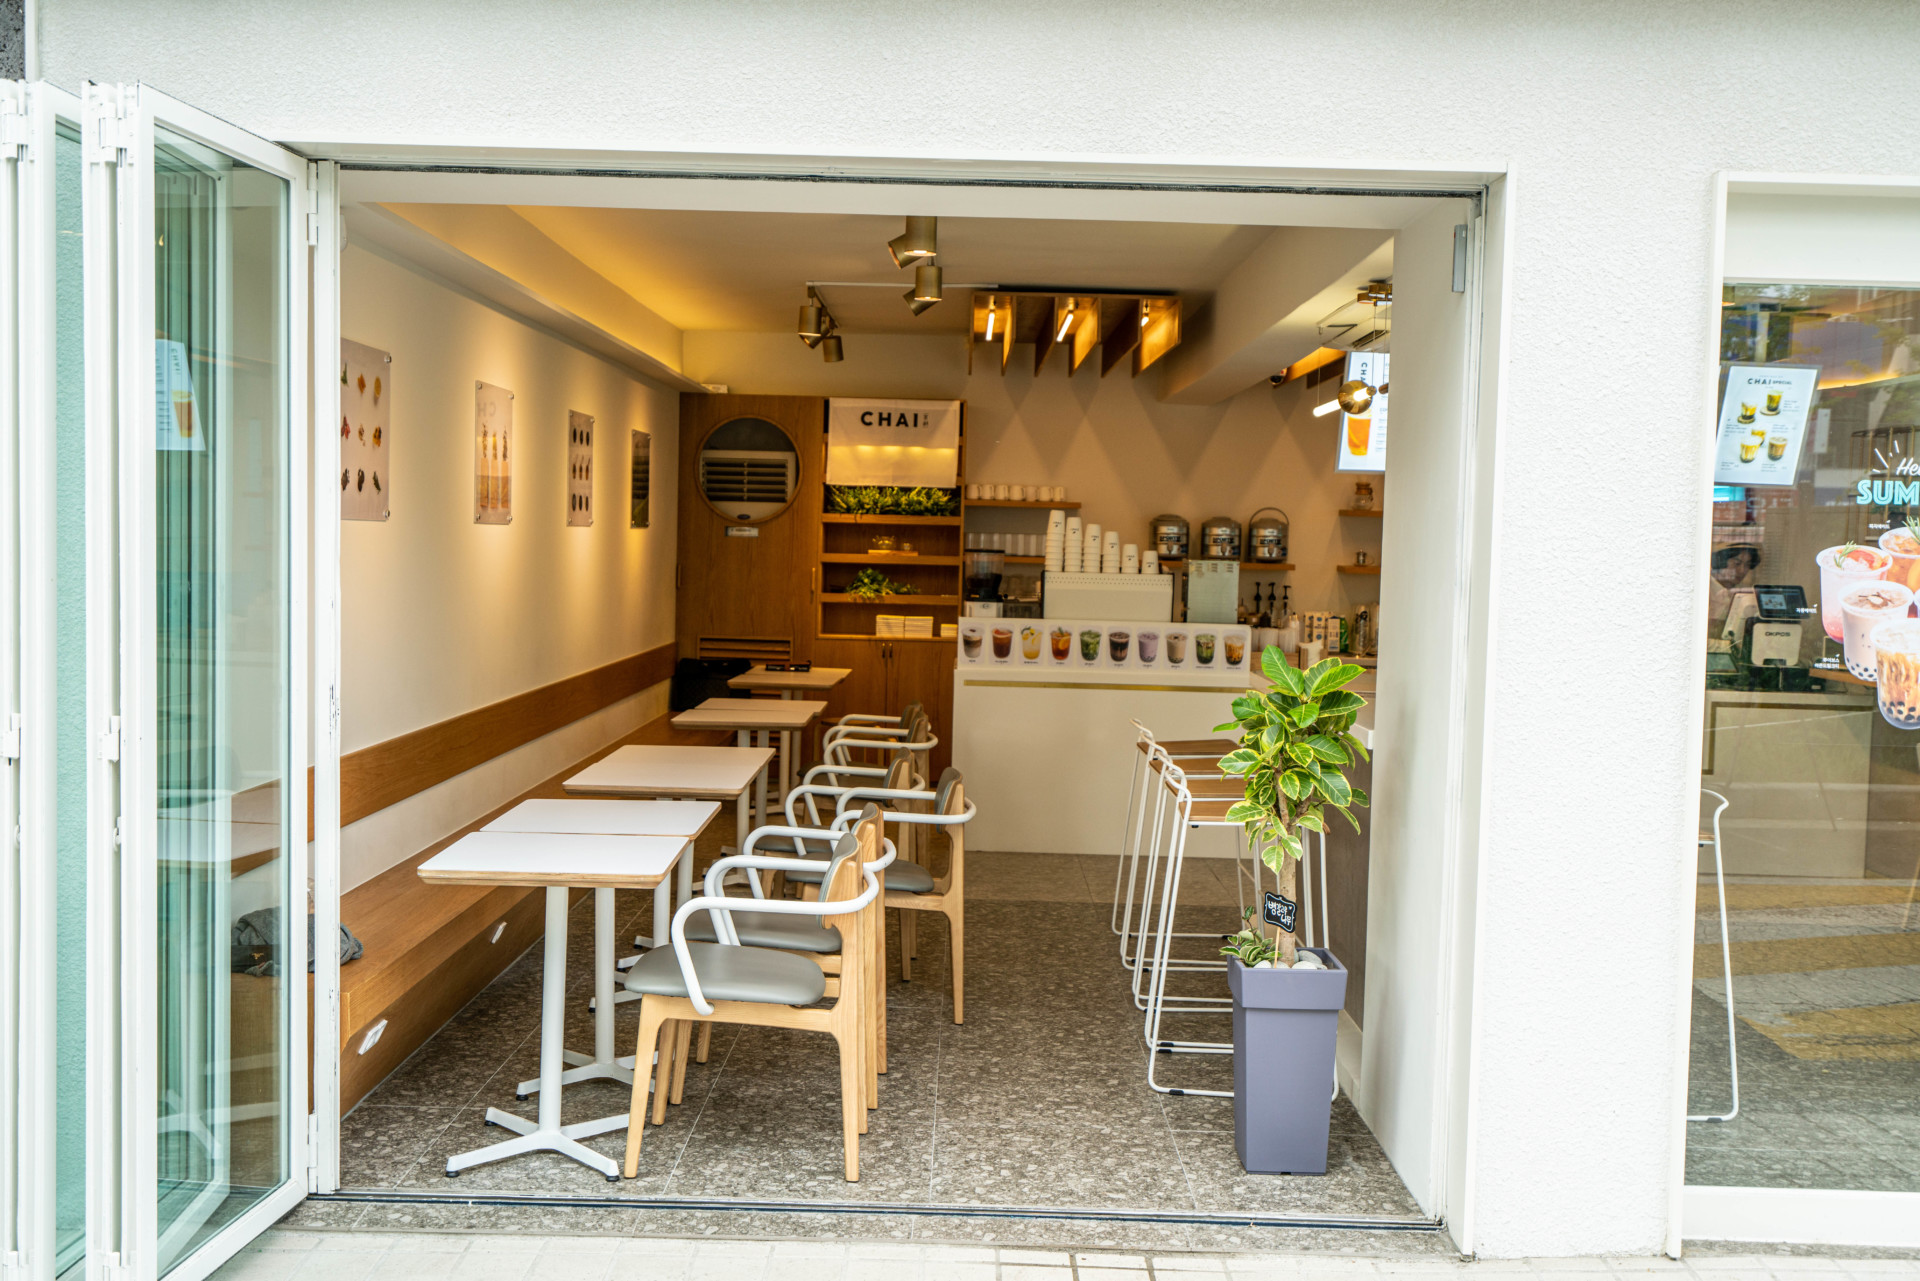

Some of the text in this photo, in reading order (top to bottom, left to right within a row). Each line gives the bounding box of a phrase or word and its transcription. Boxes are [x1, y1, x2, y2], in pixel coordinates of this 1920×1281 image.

[861, 411, 918, 427] CHAI
[1896, 457, 1920, 475] He
[1857, 480, 1920, 505] SUM
